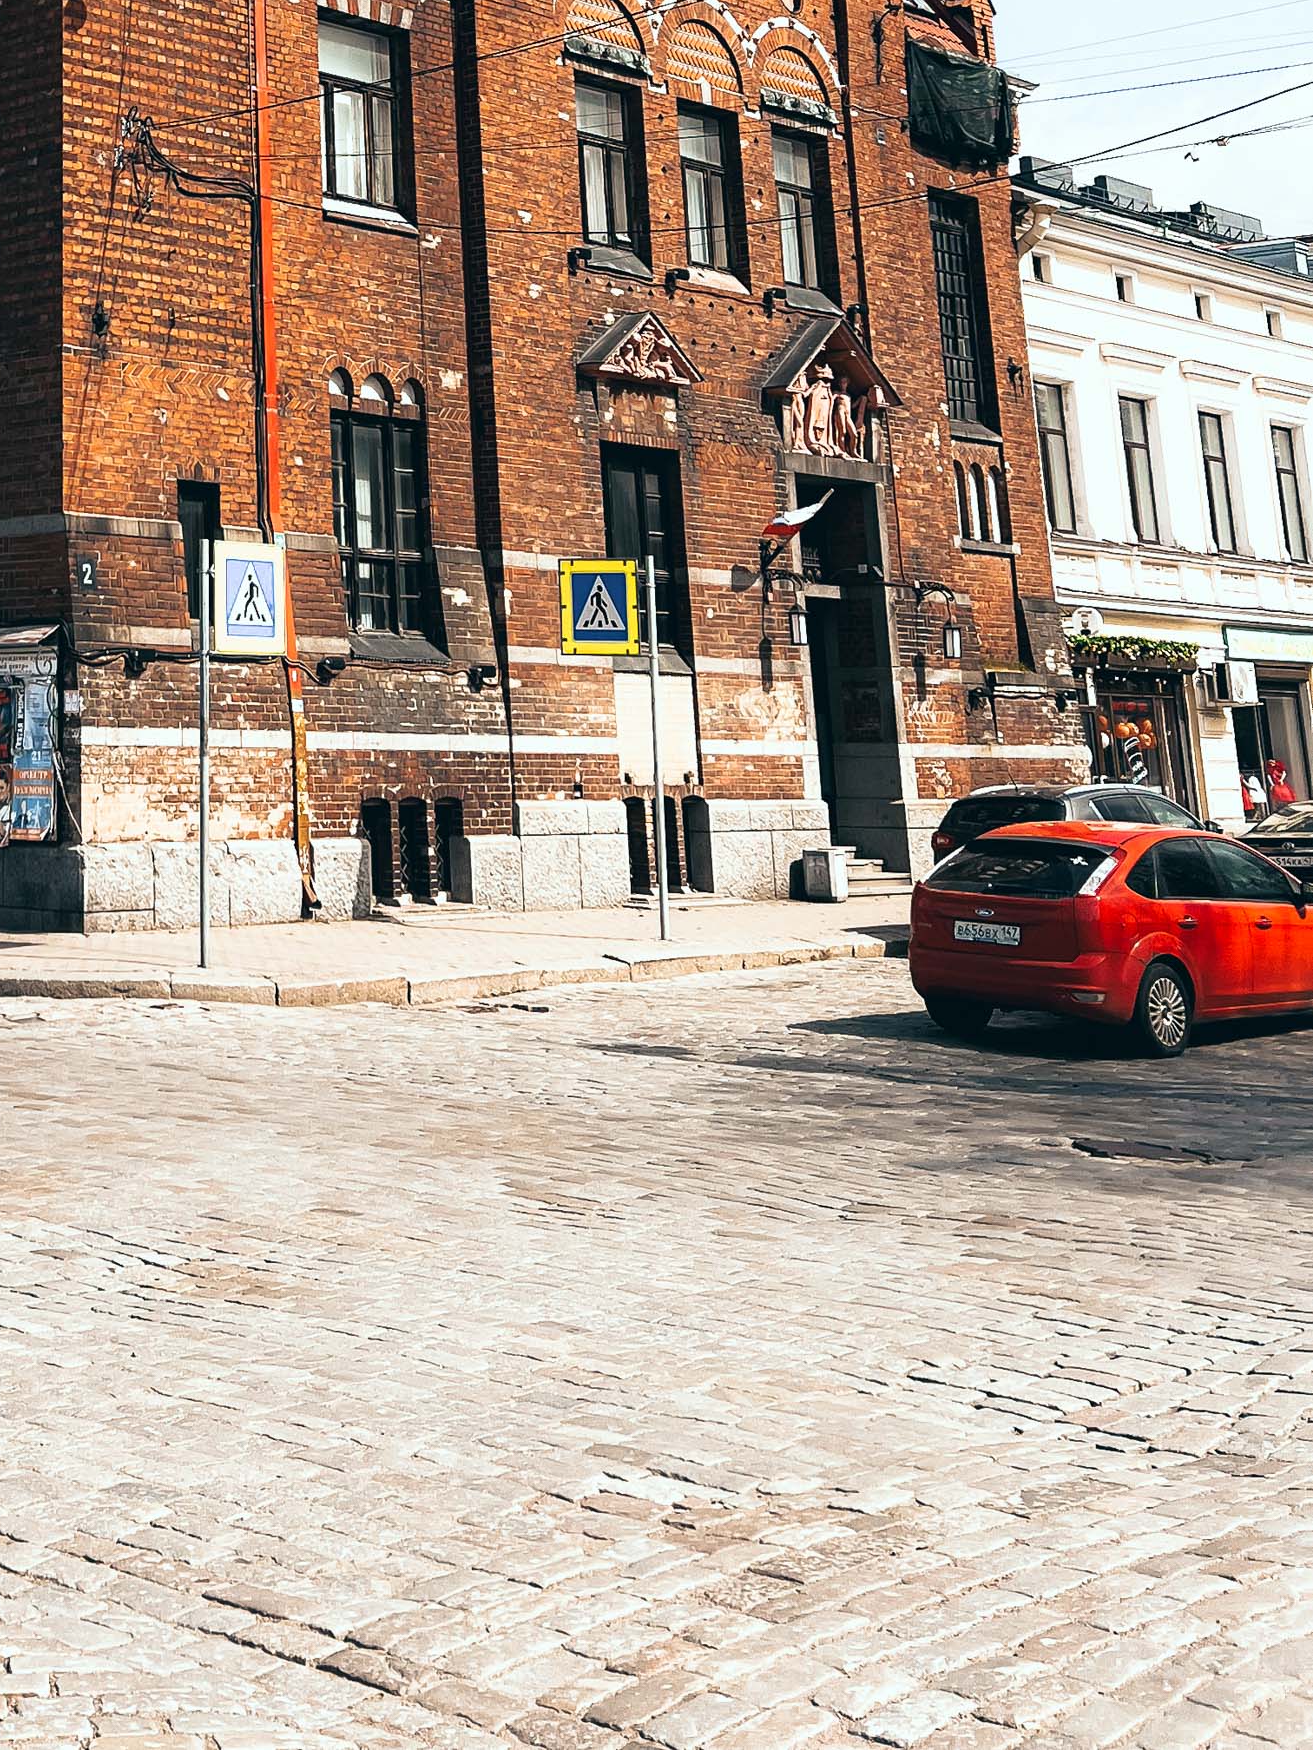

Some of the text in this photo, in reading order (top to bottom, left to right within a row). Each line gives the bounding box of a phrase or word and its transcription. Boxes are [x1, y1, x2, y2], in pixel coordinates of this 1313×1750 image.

[82, 563, 93, 584] 2
[31, 751, 41, 761] 21
[1000, 926, 1018, 938] 147
